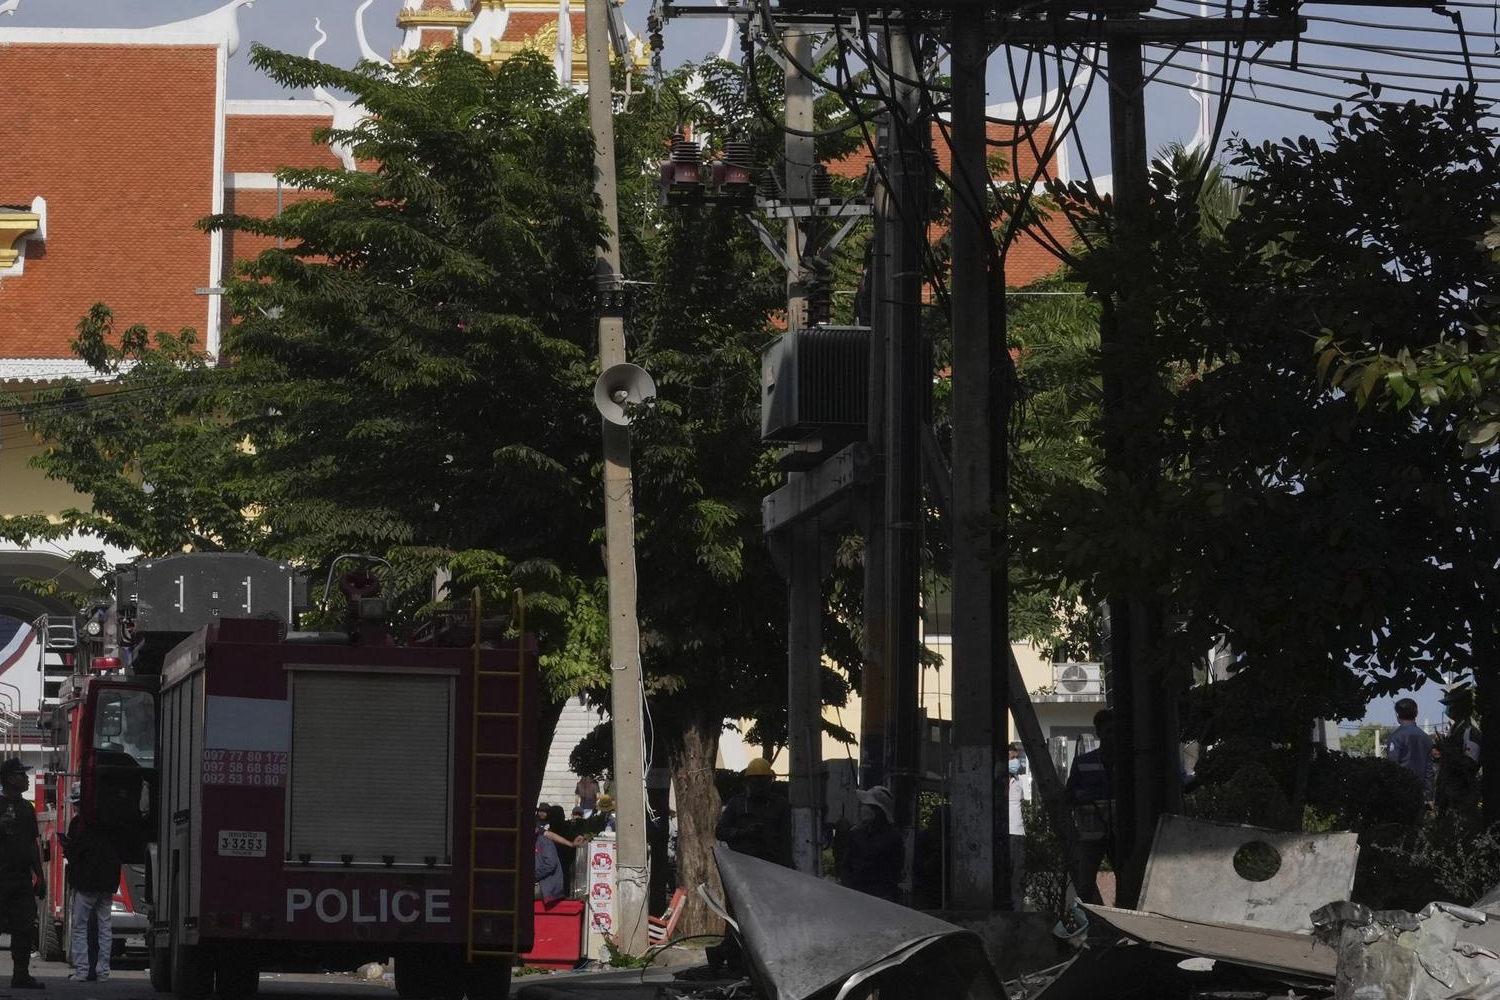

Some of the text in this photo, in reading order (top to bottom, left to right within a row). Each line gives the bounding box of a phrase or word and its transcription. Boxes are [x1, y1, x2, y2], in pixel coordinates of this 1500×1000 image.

[204, 750, 287, 763] 097 77 80 172
[204, 761, 225, 772] 097
[229, 762, 243, 773] 58
[204, 773, 279, 786] 092 53 10 80
[286, 888, 451, 923] POLICE
